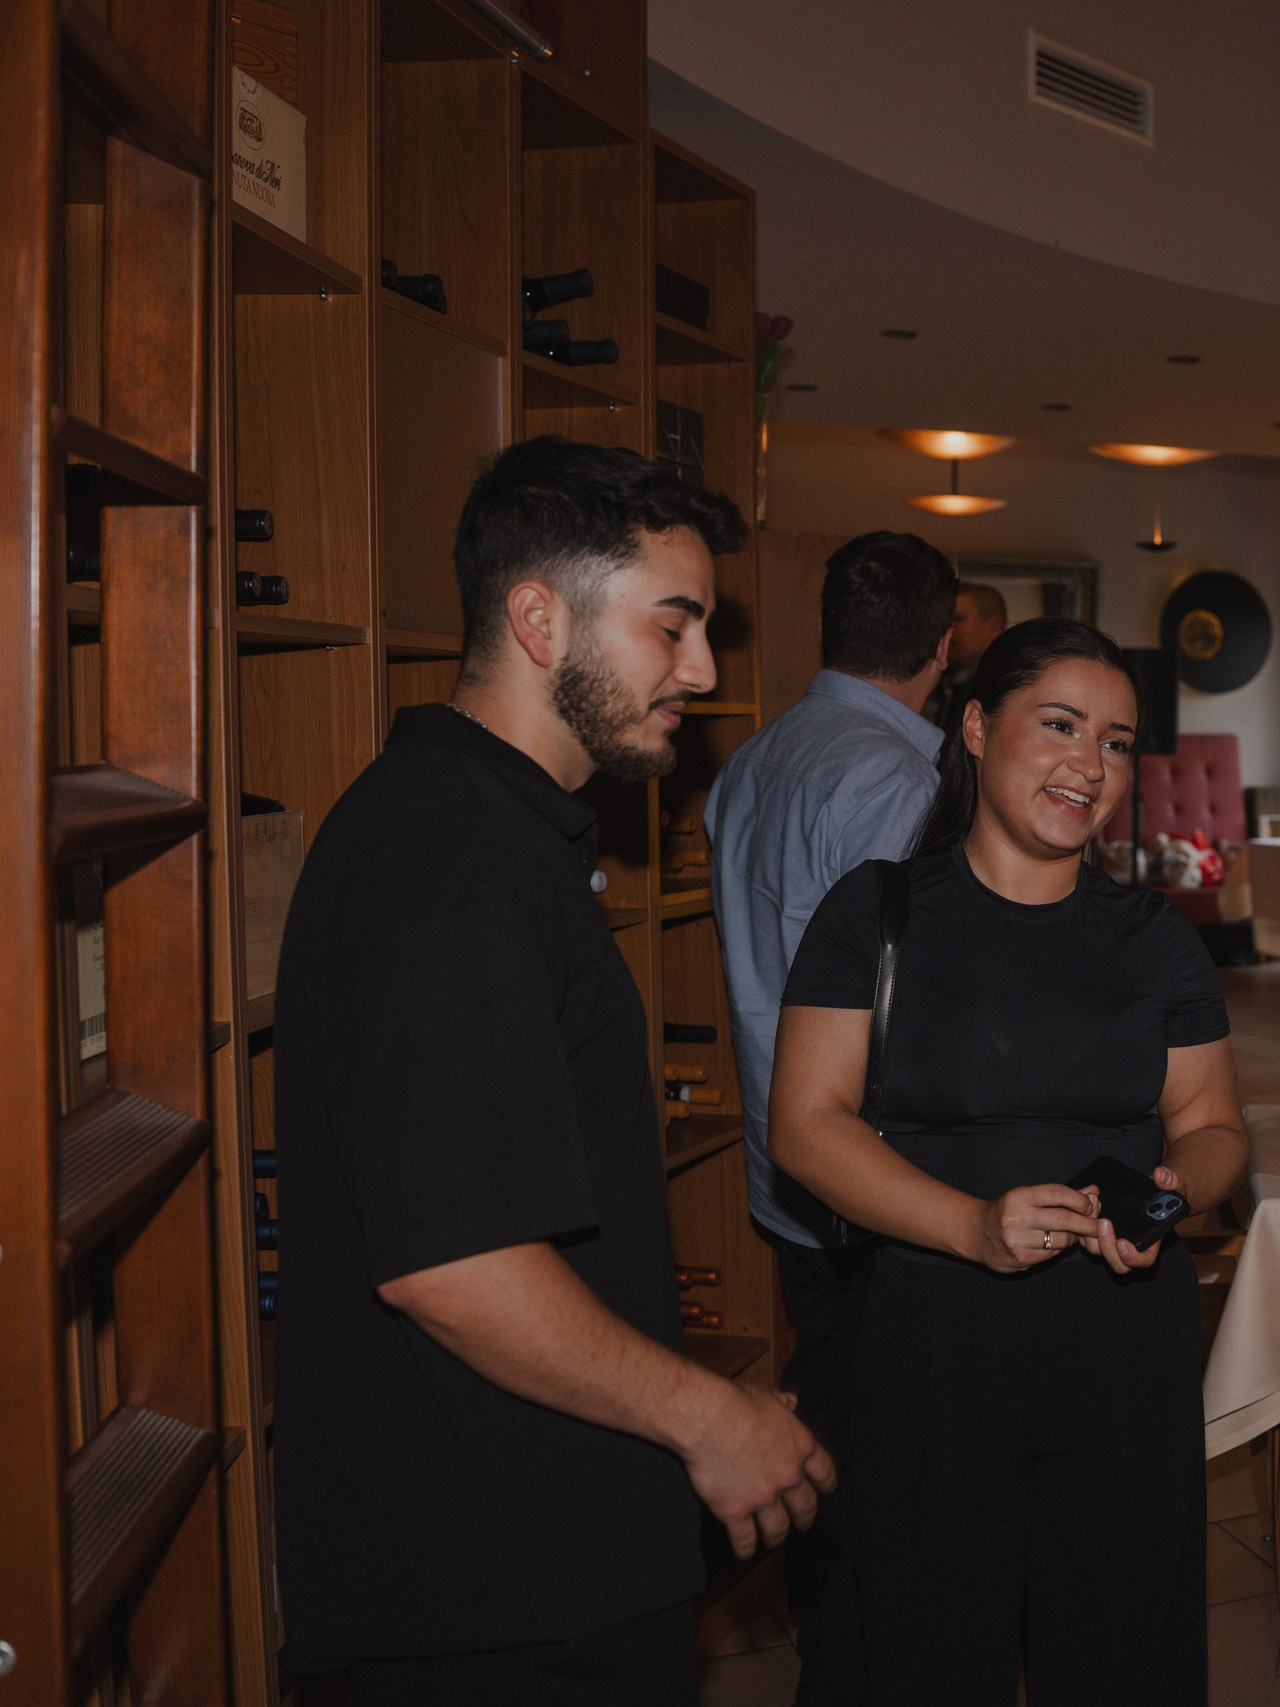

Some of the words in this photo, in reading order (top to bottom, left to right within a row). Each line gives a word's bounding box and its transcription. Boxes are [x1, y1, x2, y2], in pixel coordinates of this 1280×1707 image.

[231, 152, 256, 175] anova
[255, 158, 264, 180] di
[261, 160, 283, 191] Neri
[252, 180, 276, 208] NUOVA
